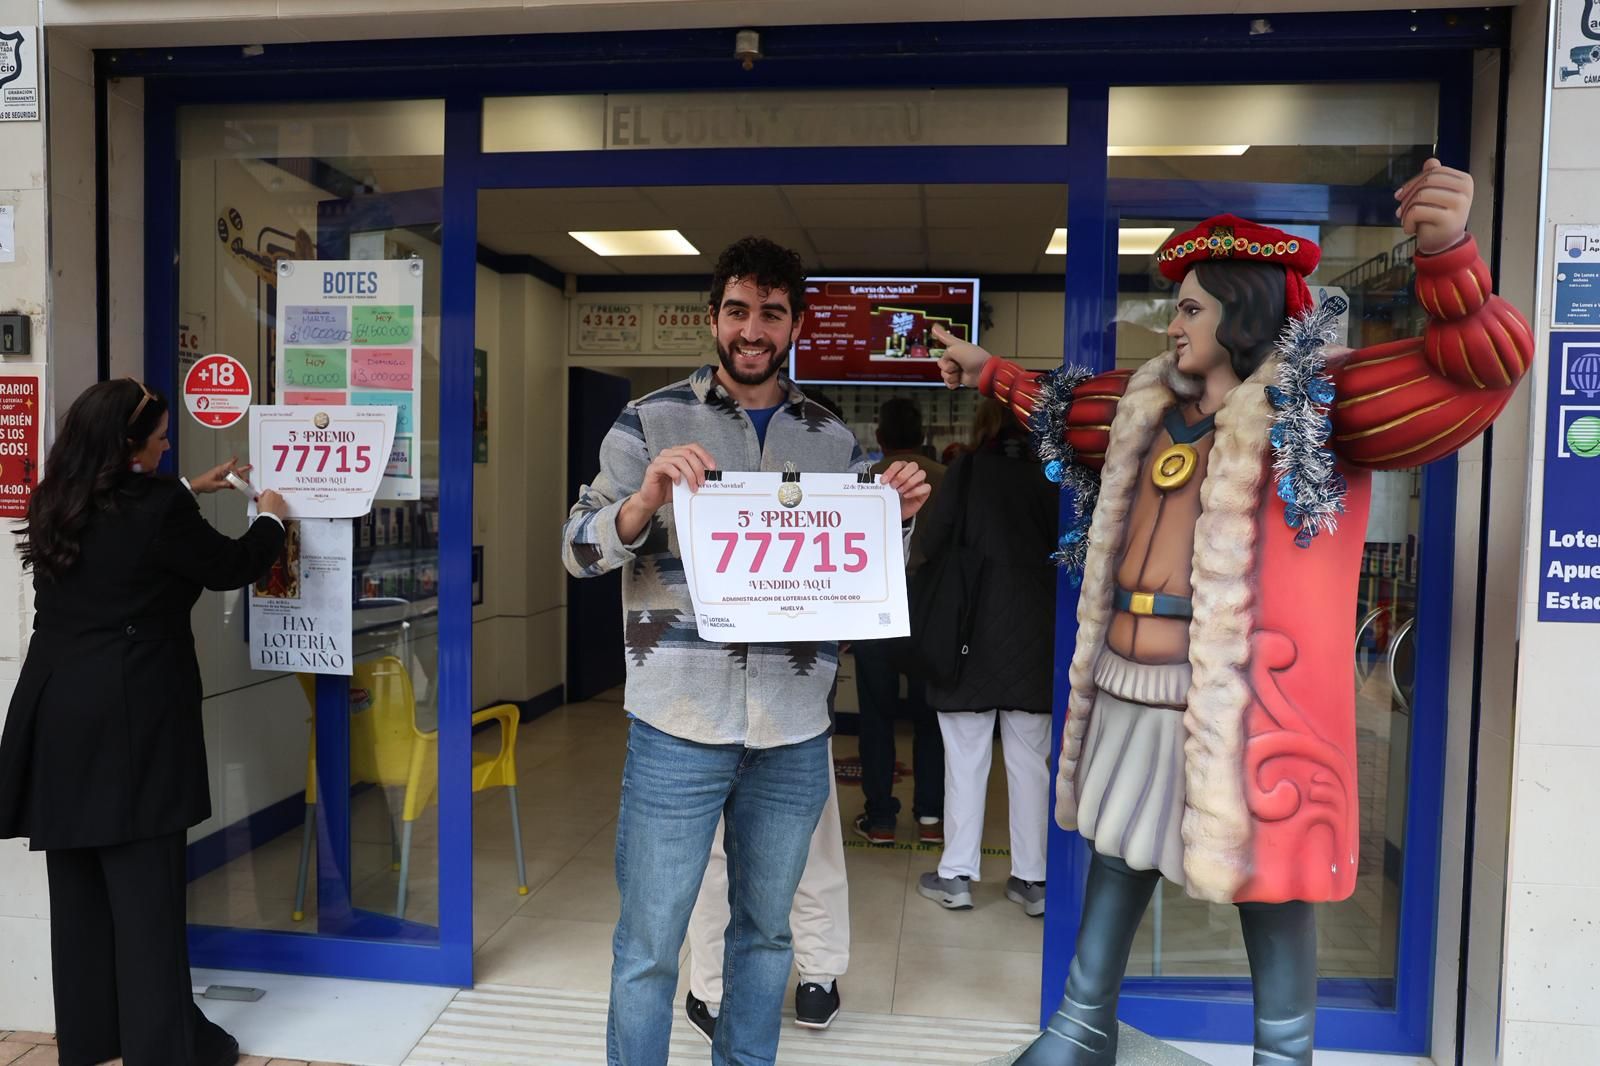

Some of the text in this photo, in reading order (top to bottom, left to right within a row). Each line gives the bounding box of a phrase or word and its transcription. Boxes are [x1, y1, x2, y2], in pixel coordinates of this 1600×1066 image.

[1591, 20, 1600, 28] a
[612, 106, 650, 146] EL
[323, 272, 378, 294] BOTES
[597, 305, 630, 313] PREMIO
[583, 314, 637, 326] 43422
[658, 314, 710, 326] 08080
[305, 357, 326, 368] HOY
[368, 358, 406, 366] DOMINGO
[198, 363, 235, 386] +18
[8, 429, 24, 440] LOS
[303, 431, 355, 442] PREMIO
[0, 443, 28, 455] GOS!
[272, 445, 371, 473] 77715
[738, 511, 841, 528] 5º PREMIO
[1549, 529, 1600, 547] Lote
[712, 532, 868, 573] 77715
[1547, 560, 1600, 583] Apue
[749, 577, 831, 591] VENDIDO AQUÍ
[283, 616, 318, 631] HAY
[264, 633, 336, 651] LOTERÍA
[261, 649, 344, 668] DEL NIÑO
